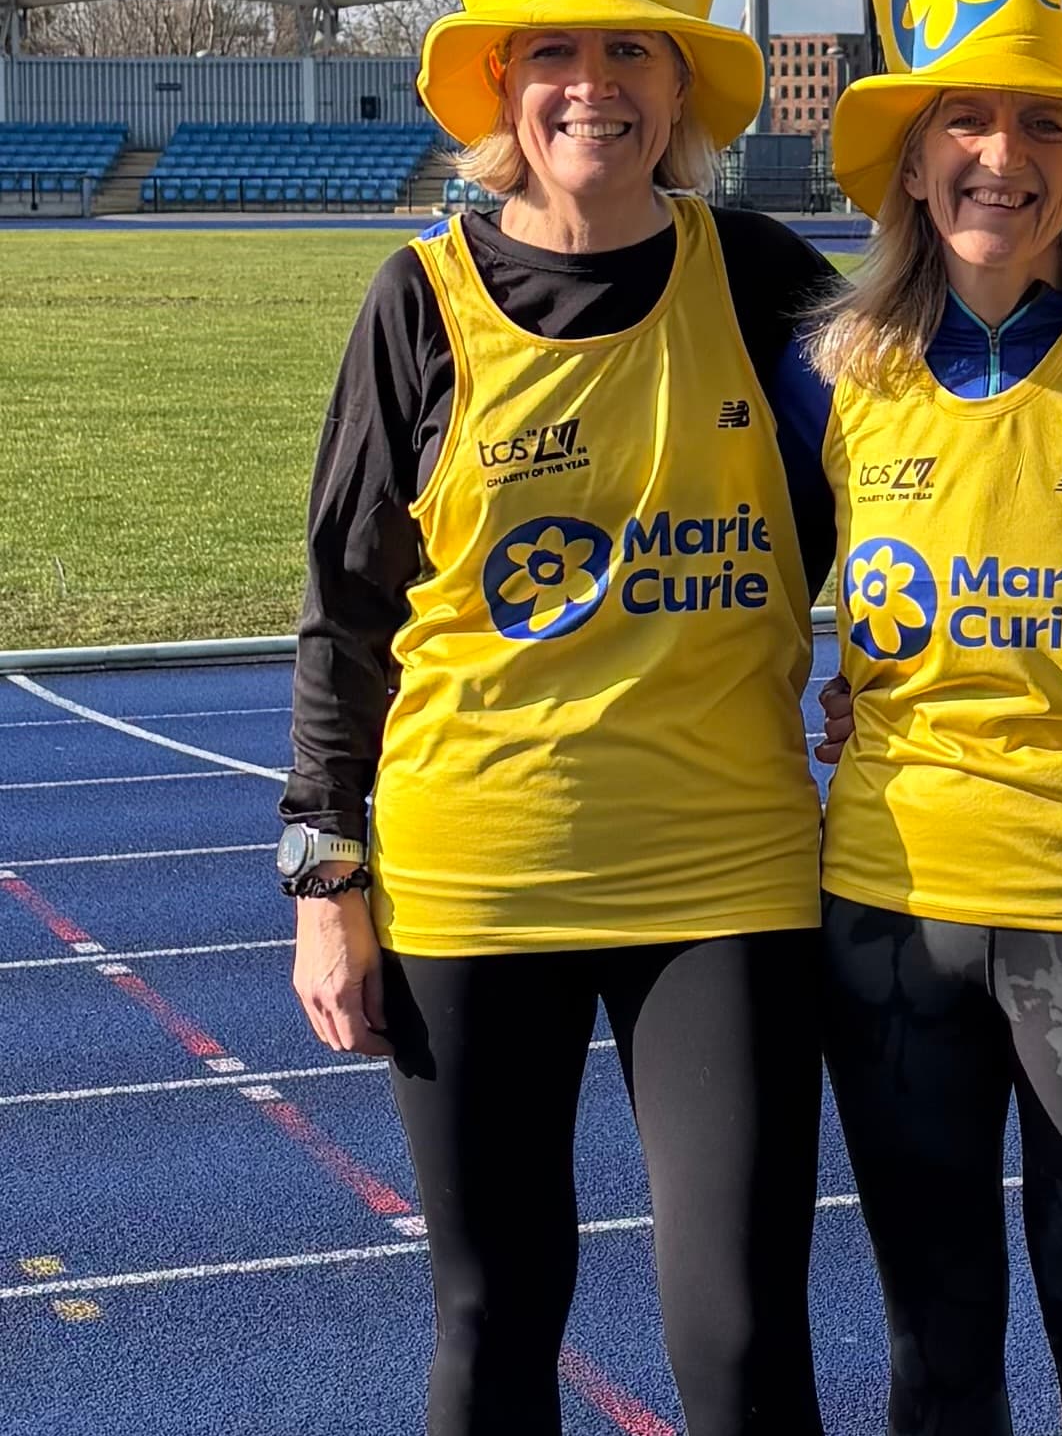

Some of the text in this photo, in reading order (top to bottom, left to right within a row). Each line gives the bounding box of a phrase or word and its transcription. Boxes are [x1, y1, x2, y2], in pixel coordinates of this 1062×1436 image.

[478, 437, 528, 467] tcs
[531, 467, 545, 478] OF
[860, 461, 892, 486] tcs
[623, 503, 771, 562] Marie
[620, 561, 768, 615] Curie
